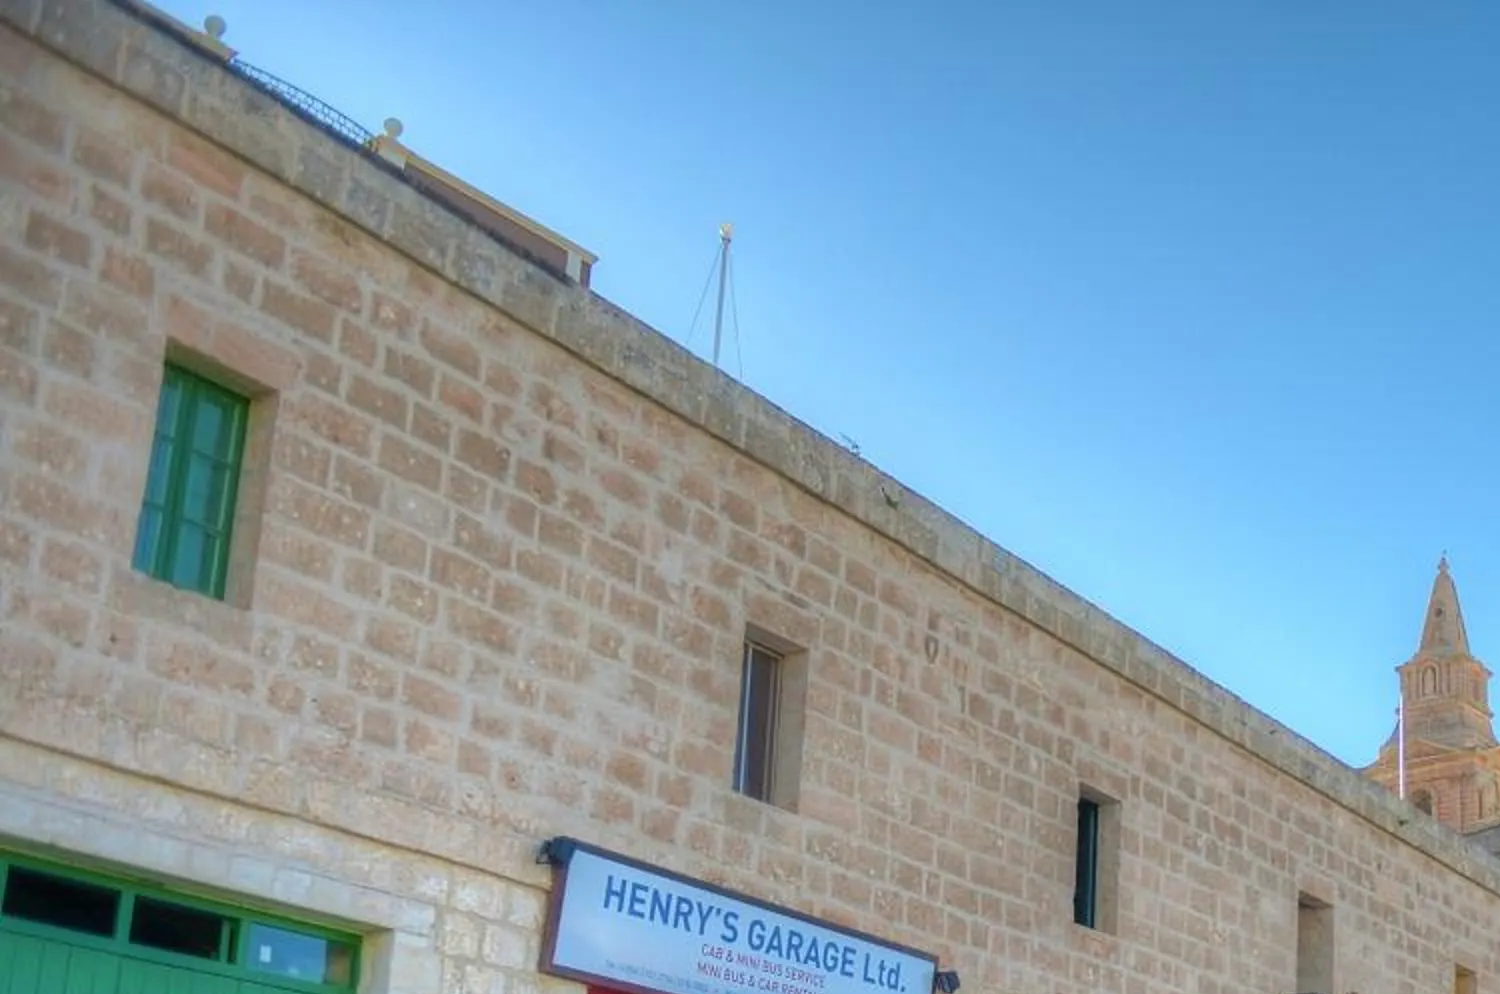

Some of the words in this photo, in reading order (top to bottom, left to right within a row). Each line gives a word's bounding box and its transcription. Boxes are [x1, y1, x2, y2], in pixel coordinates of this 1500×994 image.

[603, 875, 739, 943] HENRY'S
[747, 919, 857, 977] GARAGE
[863, 952, 906, 992] Ltd.
[697, 961, 721, 979] MINI
[723, 968, 745, 985] BUS
[758, 978, 779, 993] CAR
[702, 944, 724, 960] CAB
[735, 953, 760, 969] MINI
[761, 959, 782, 976] BUS
[785, 966, 826, 988] SERVICE
